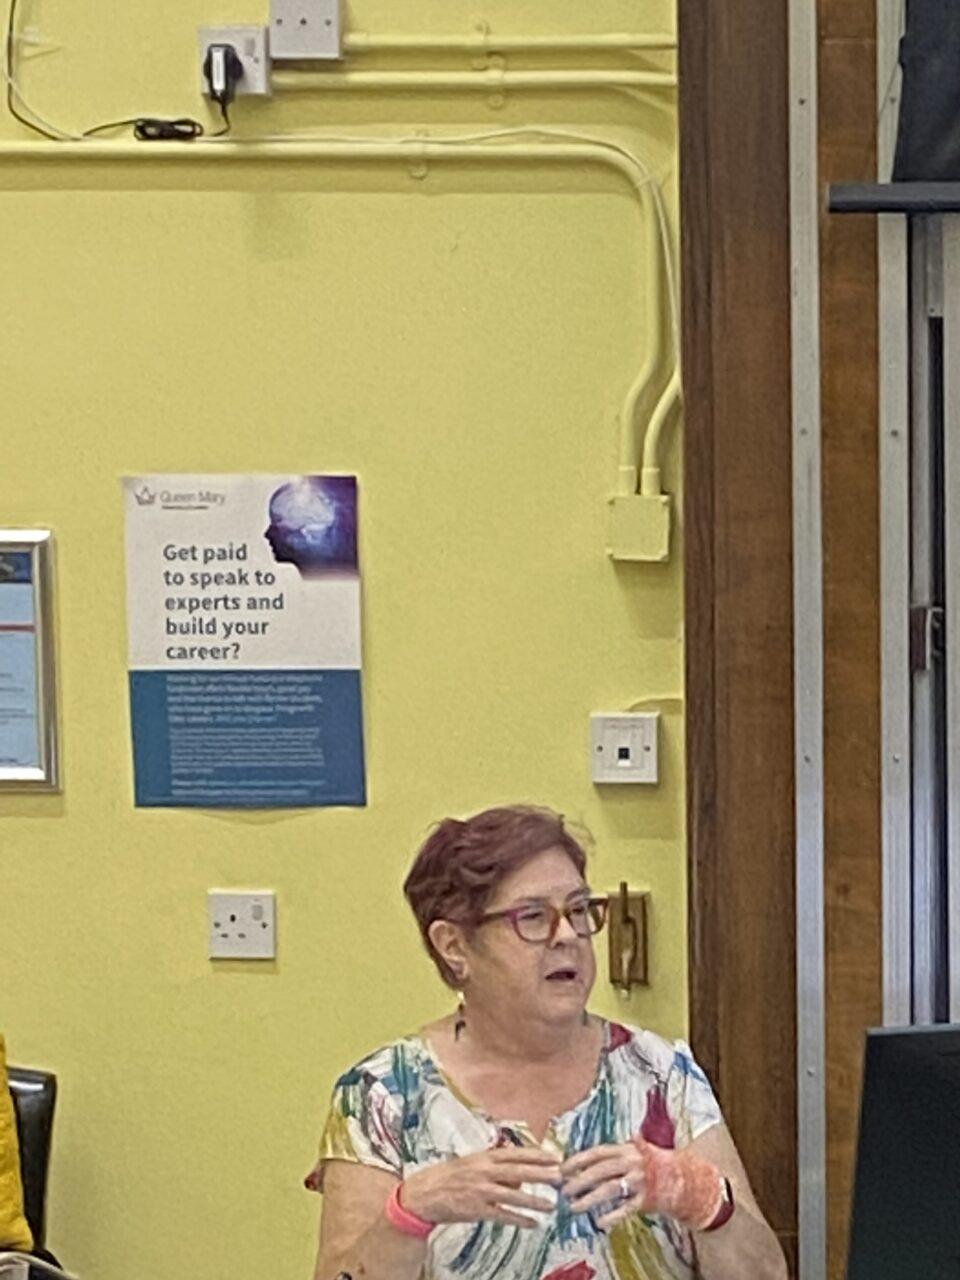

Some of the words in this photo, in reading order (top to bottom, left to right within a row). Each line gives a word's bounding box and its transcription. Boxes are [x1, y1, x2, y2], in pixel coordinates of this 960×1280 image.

[163, 544, 197, 561] Get
[203, 542, 247, 565] paid
[163, 570, 185, 586] to
[189, 568, 249, 590] speak
[254, 570, 276, 586] to
[165, 595, 240, 614] experts
[246, 593, 284, 610] and
[166, 617, 217, 635] build
[222, 622, 270, 640] your
[166, 642, 240, 660] career?
